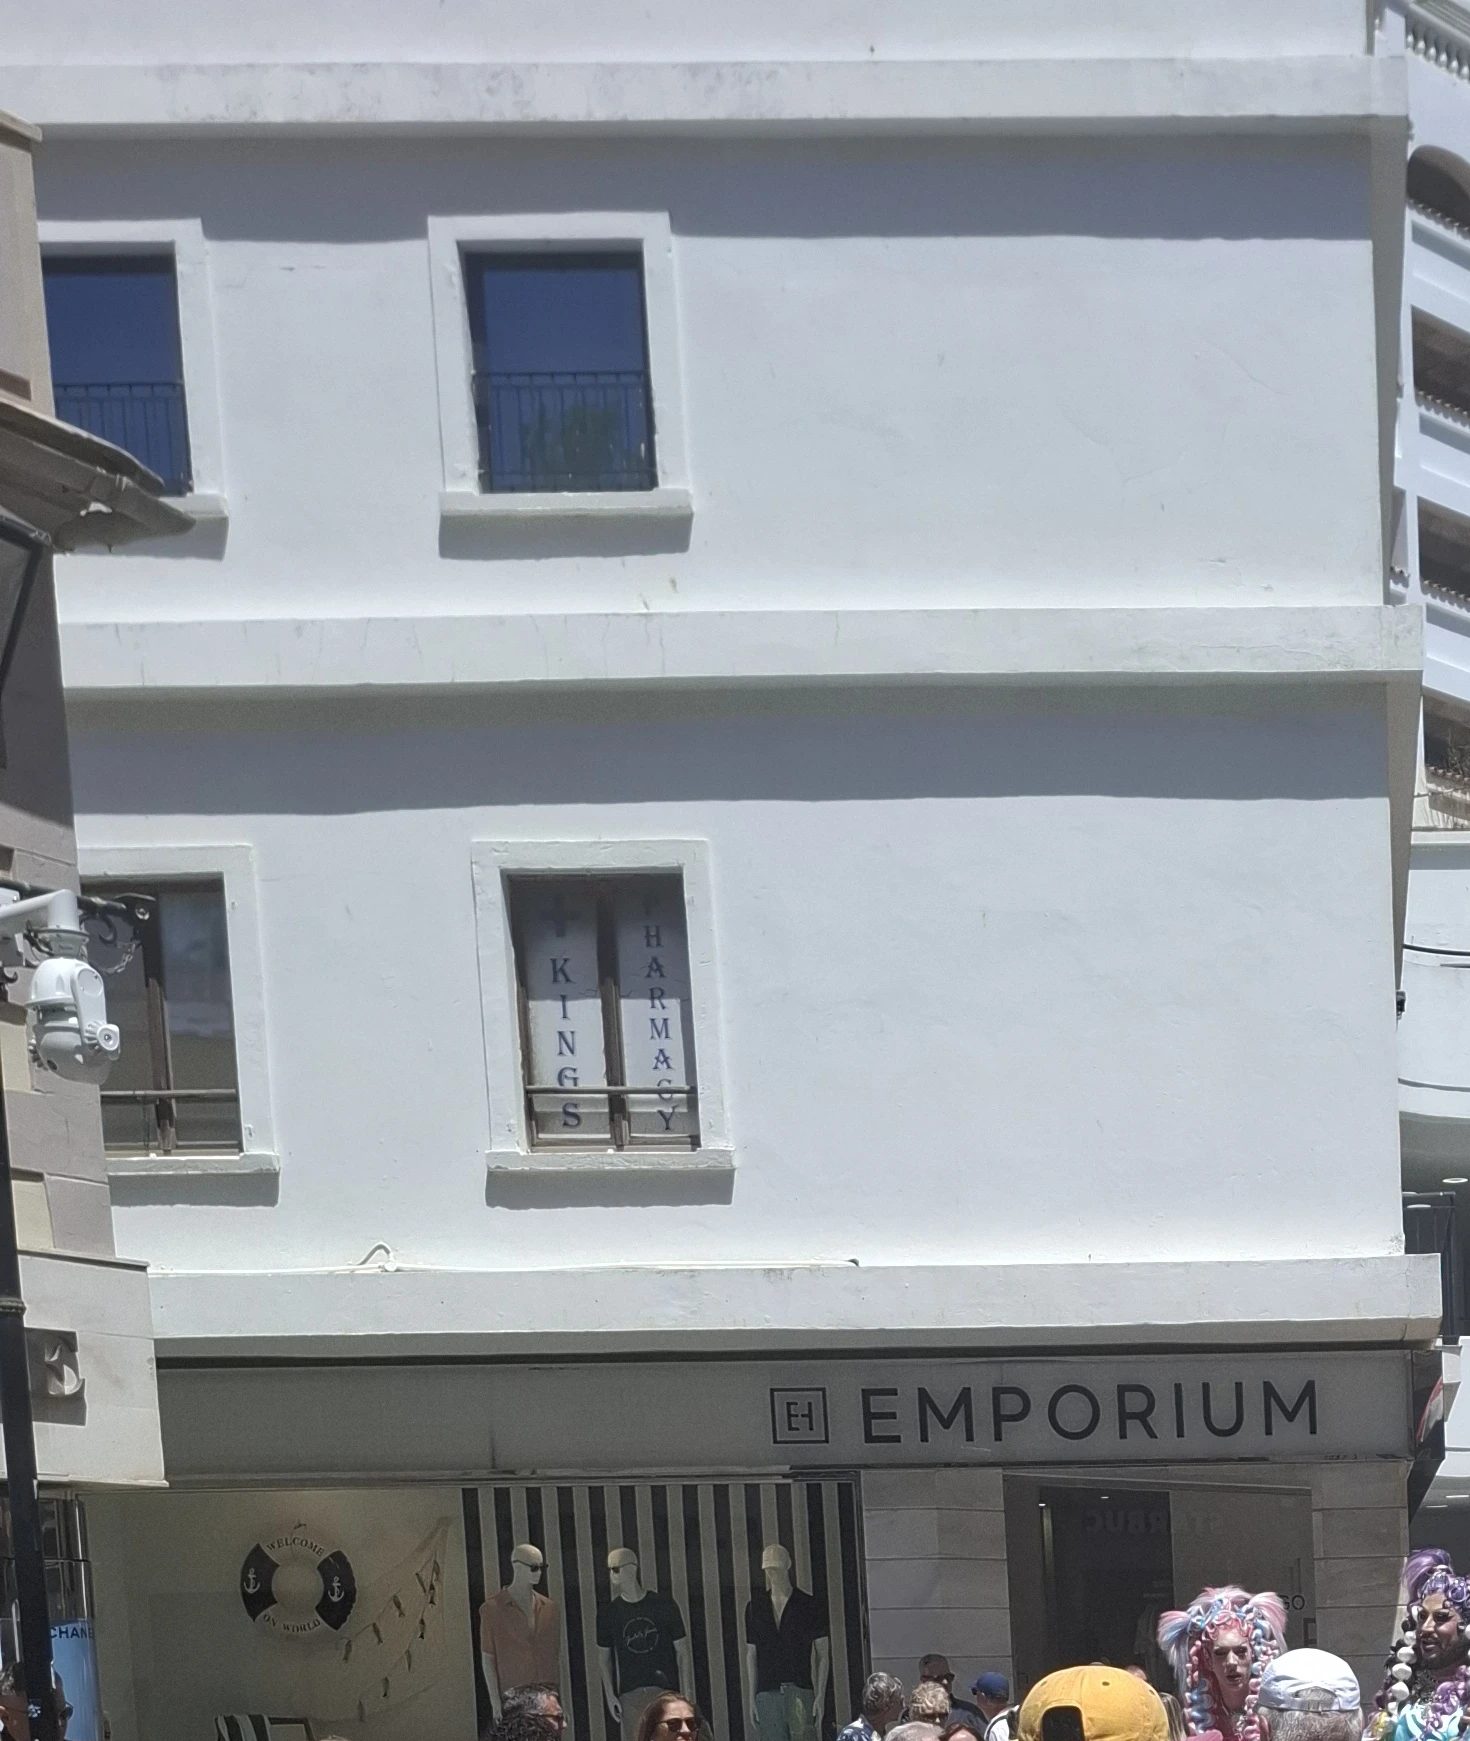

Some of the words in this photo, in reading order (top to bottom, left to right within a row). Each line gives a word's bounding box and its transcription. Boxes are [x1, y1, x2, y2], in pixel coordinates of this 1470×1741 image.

[643, 895, 678, 1132] HARMACY
[861, 1379, 1318, 1444] EMPORIUM
[266, 1536, 325, 1557] WELCOME
